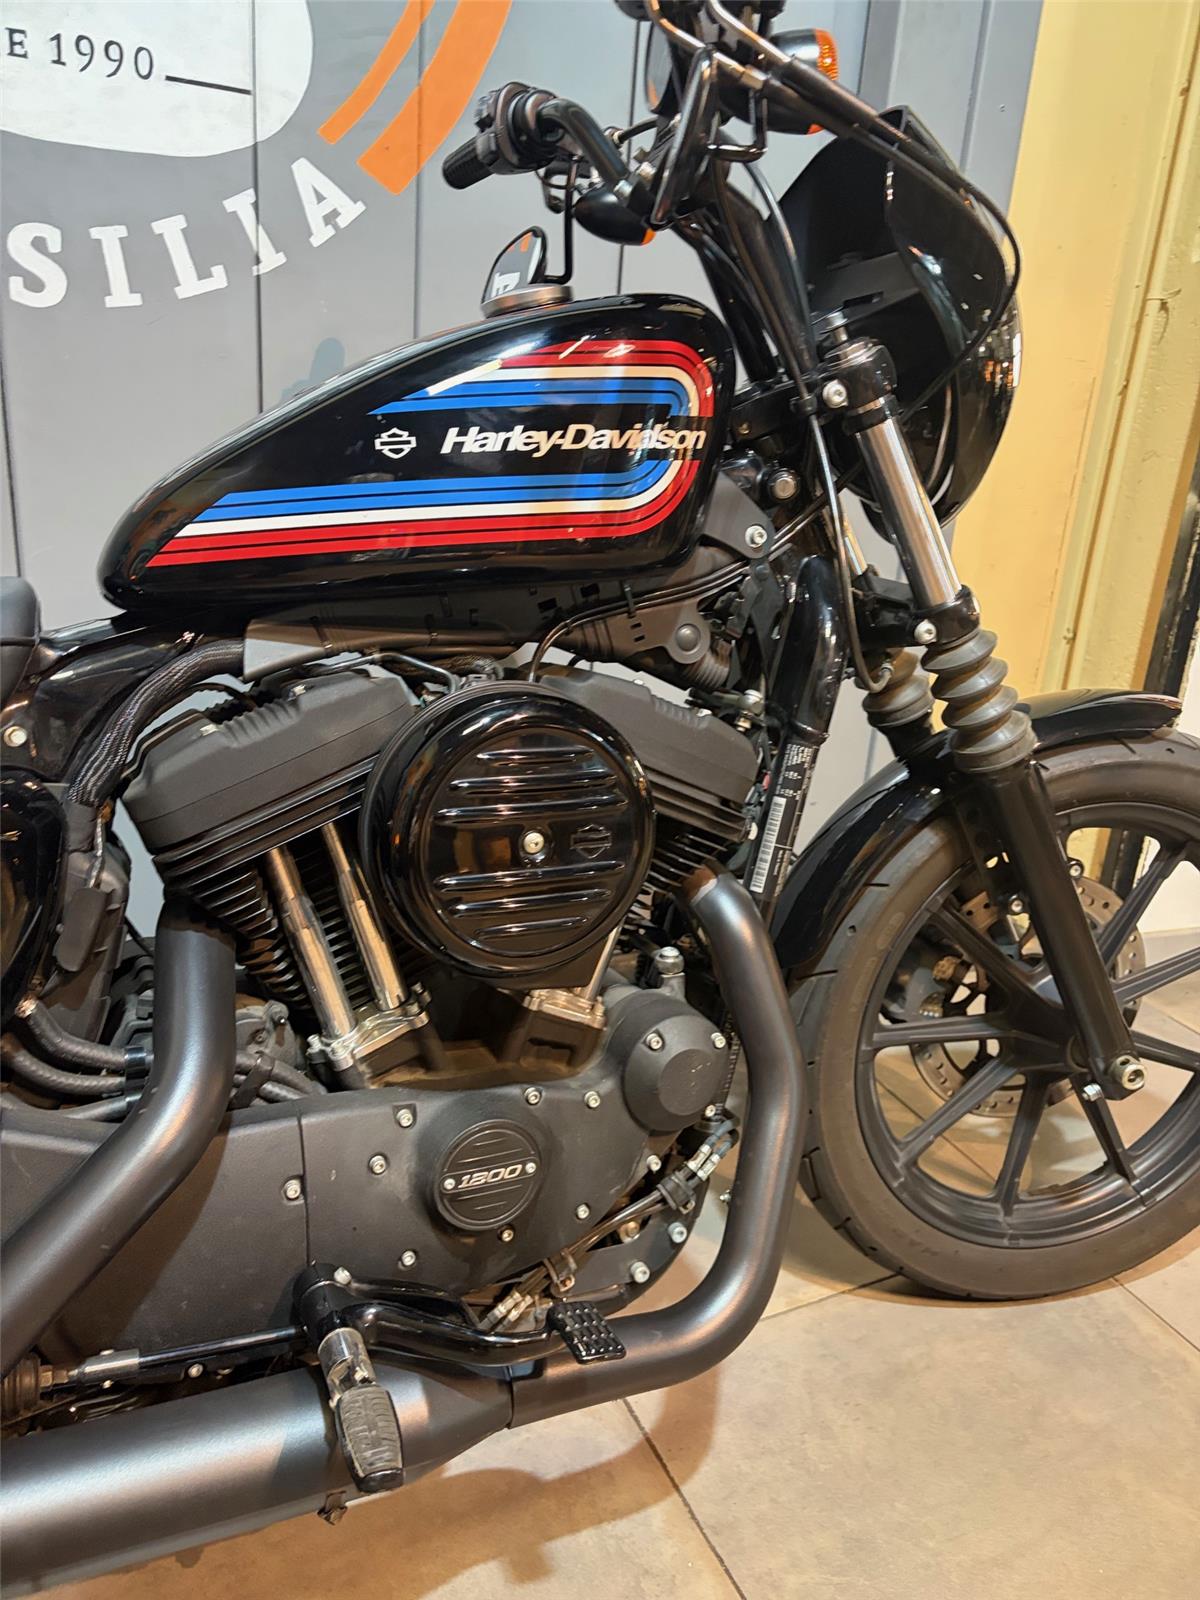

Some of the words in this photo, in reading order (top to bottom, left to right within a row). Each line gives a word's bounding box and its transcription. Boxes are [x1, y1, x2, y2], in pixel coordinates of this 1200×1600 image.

[49, 33, 154, 80] 1990
[6, 157, 366, 308] SILIA
[440, 423, 707, 458] Harley-Davidson
[457, 1164, 523, 1189] 1200
